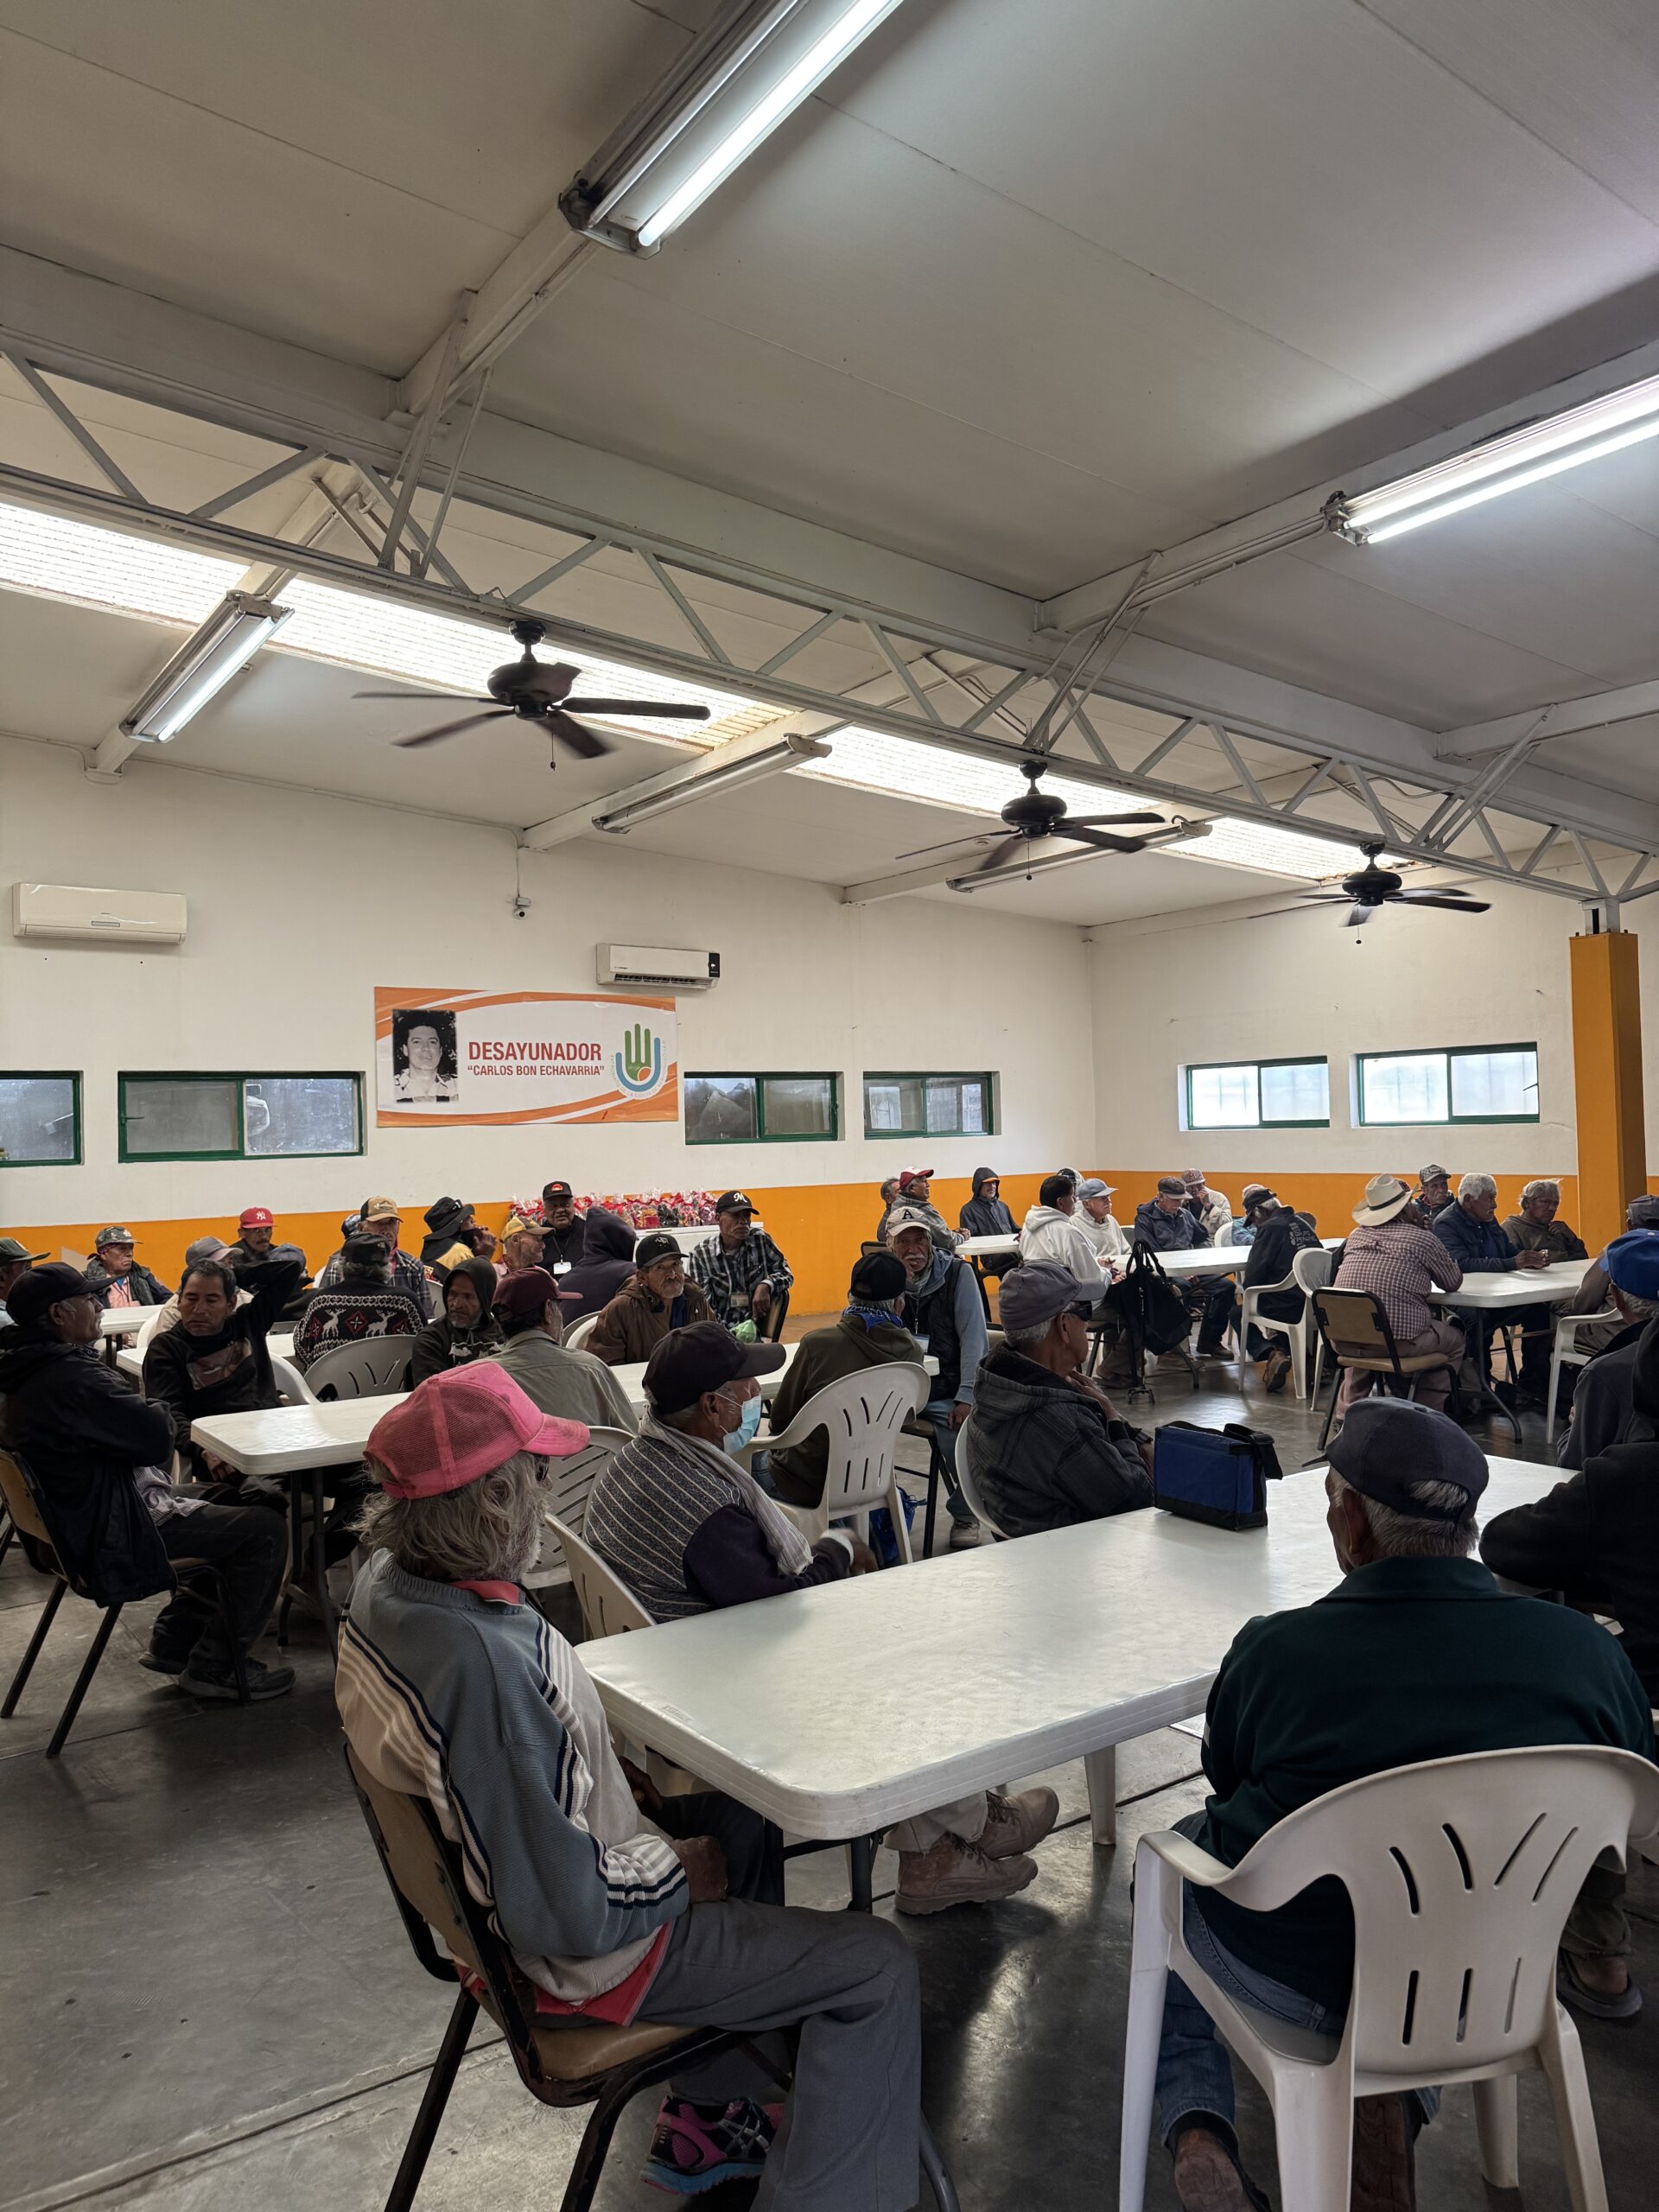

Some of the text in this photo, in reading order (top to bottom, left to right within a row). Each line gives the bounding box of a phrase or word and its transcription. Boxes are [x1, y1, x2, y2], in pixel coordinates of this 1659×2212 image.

[468, 1041, 602, 1061] DESAYUNADOR
[516, 1065, 537, 1076] BON
[733, 1192, 747, 1203] M
[256, 1211, 266, 1220] NY
[901, 1210, 915, 1220] A
